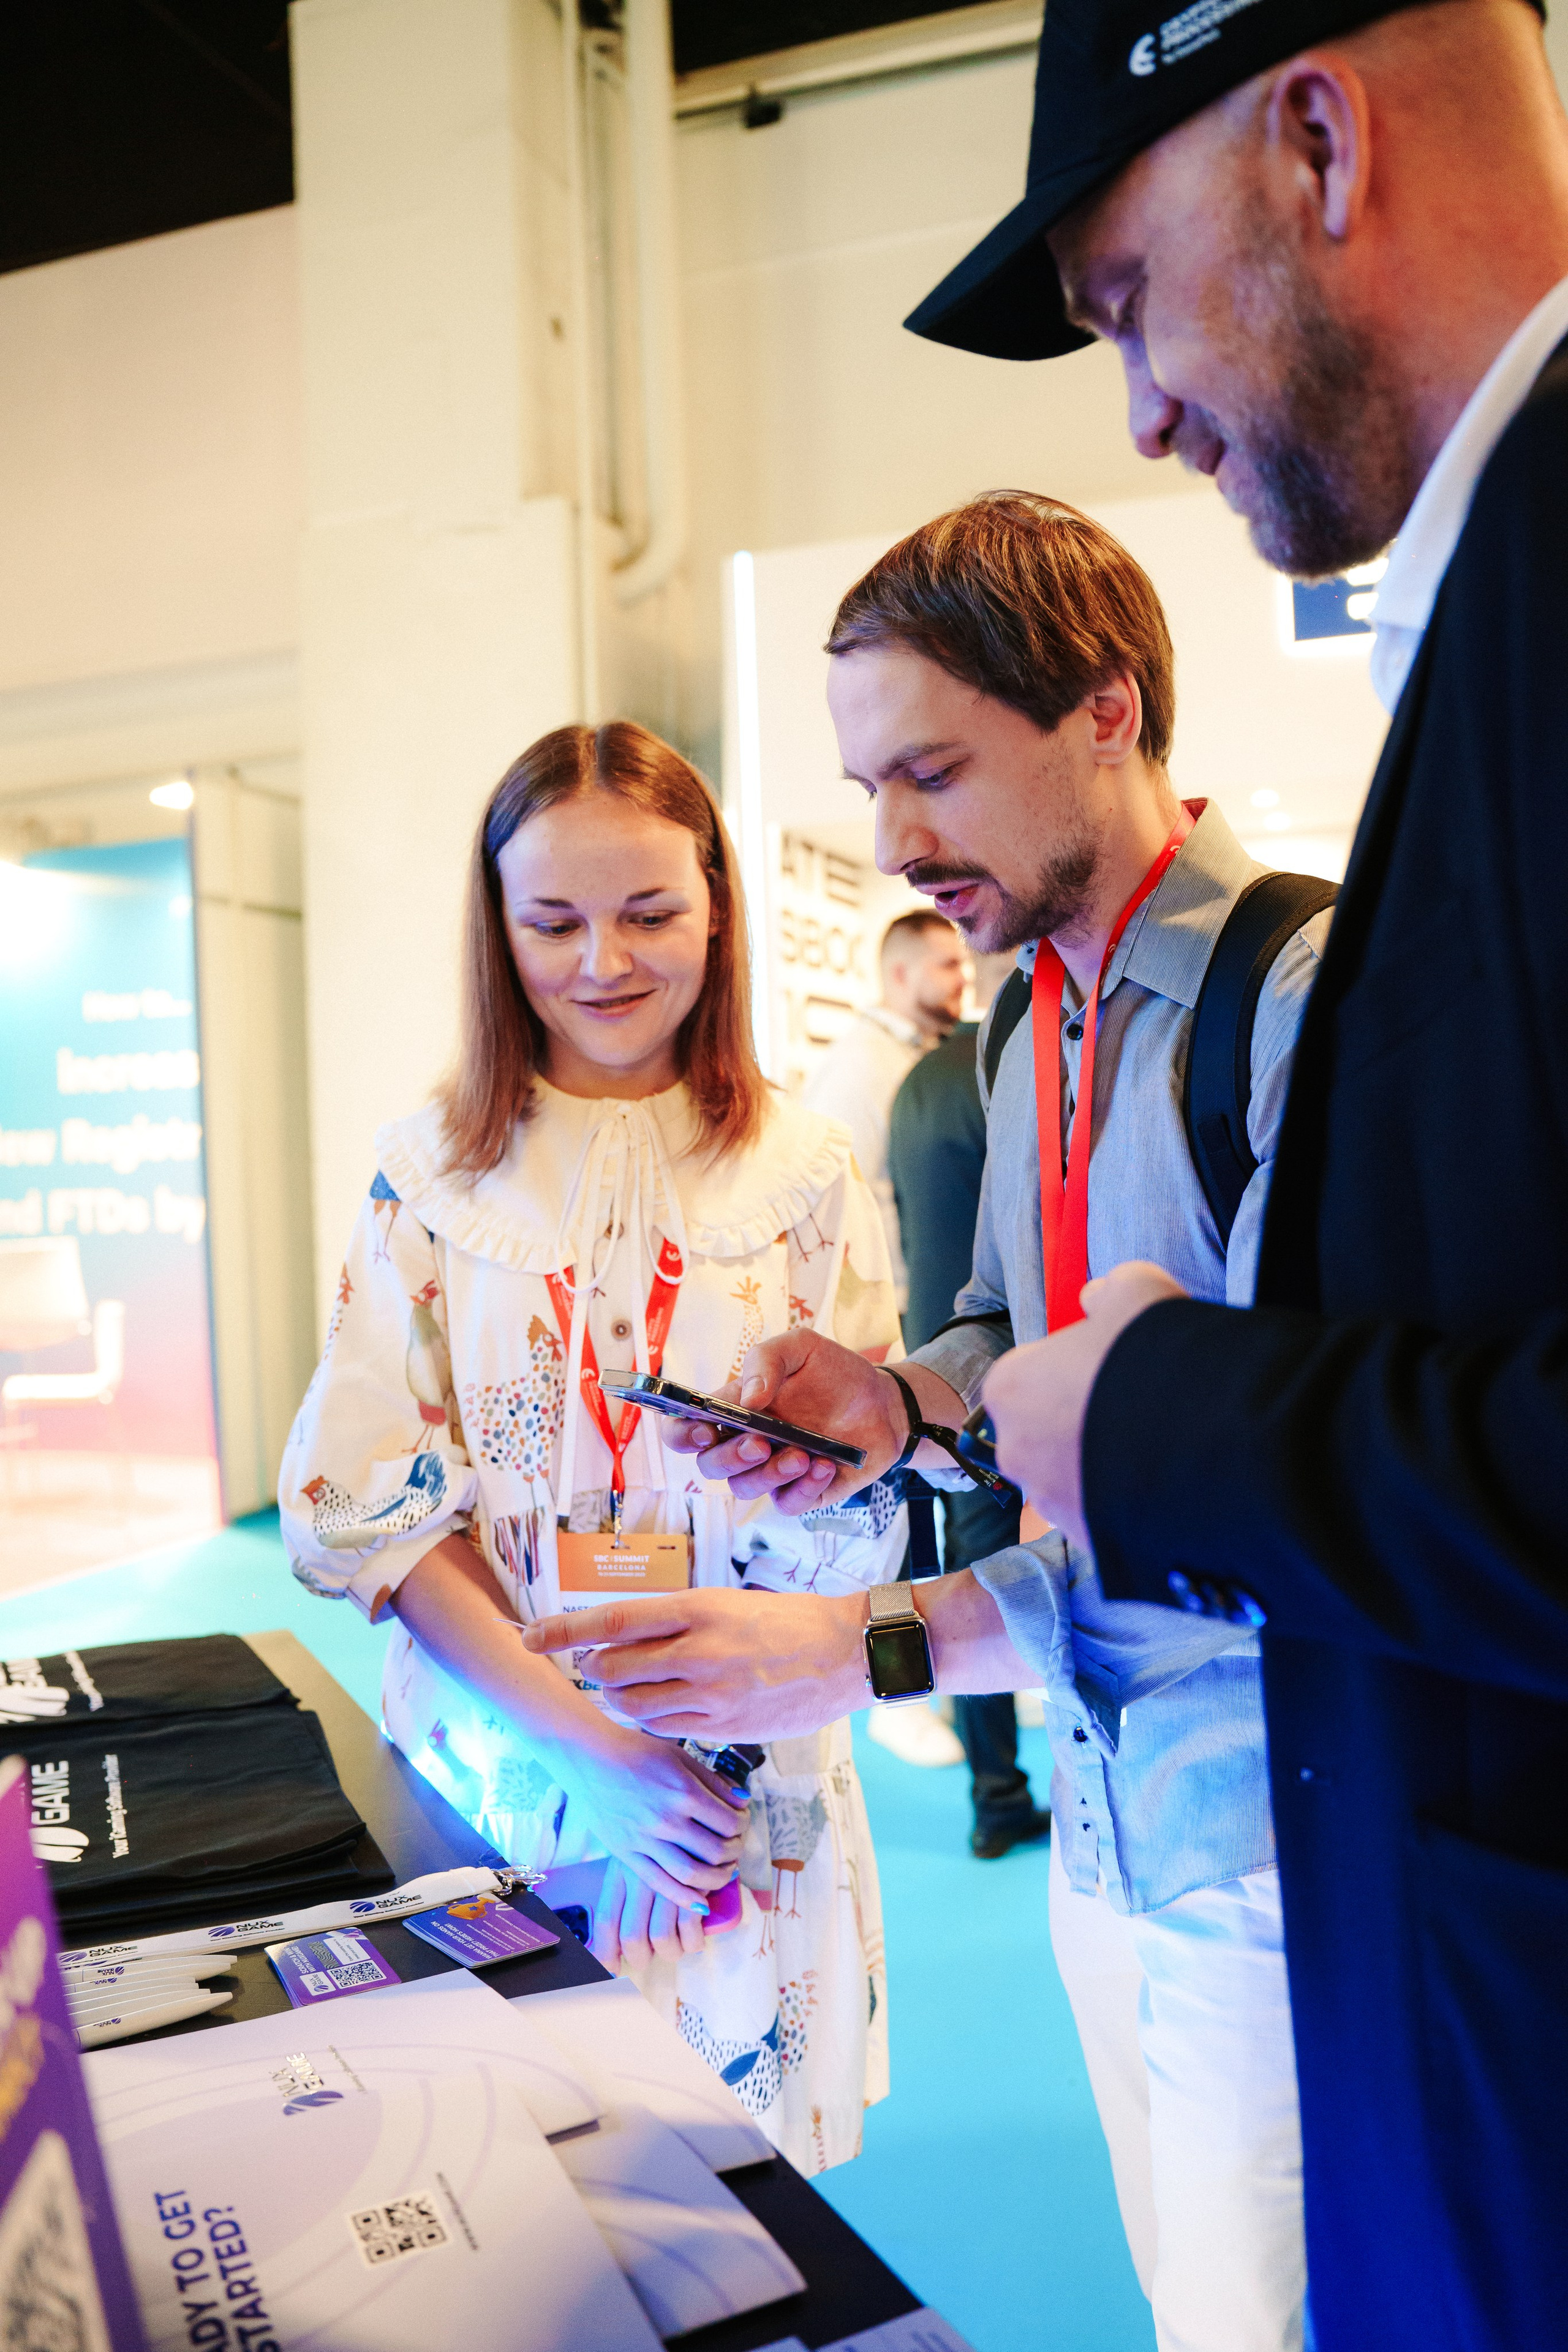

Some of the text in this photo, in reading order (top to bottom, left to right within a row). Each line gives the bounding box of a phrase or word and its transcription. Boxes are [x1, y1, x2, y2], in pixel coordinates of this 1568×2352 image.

[31, 1760, 70, 1825] GAME
[376, 1895, 407, 1905] NUX
[378, 1894, 422, 1908] GAME
[238, 1921, 284, 1932] GAME
[437, 1926, 456, 1936] HANDS
[451, 1935, 467, 1943] YOUR
[89, 1945, 123, 1954] NUX
[89, 1946, 138, 1957] GAME
[472, 1947, 493, 1959] WANNA
[291, 1957, 309, 1973] SCRATCH
[304, 1961, 317, 1972] WITH
[312, 1973, 324, 1985] GAME
[154, 2190, 197, 2241] GET
[172, 2247, 210, 2294] TO
